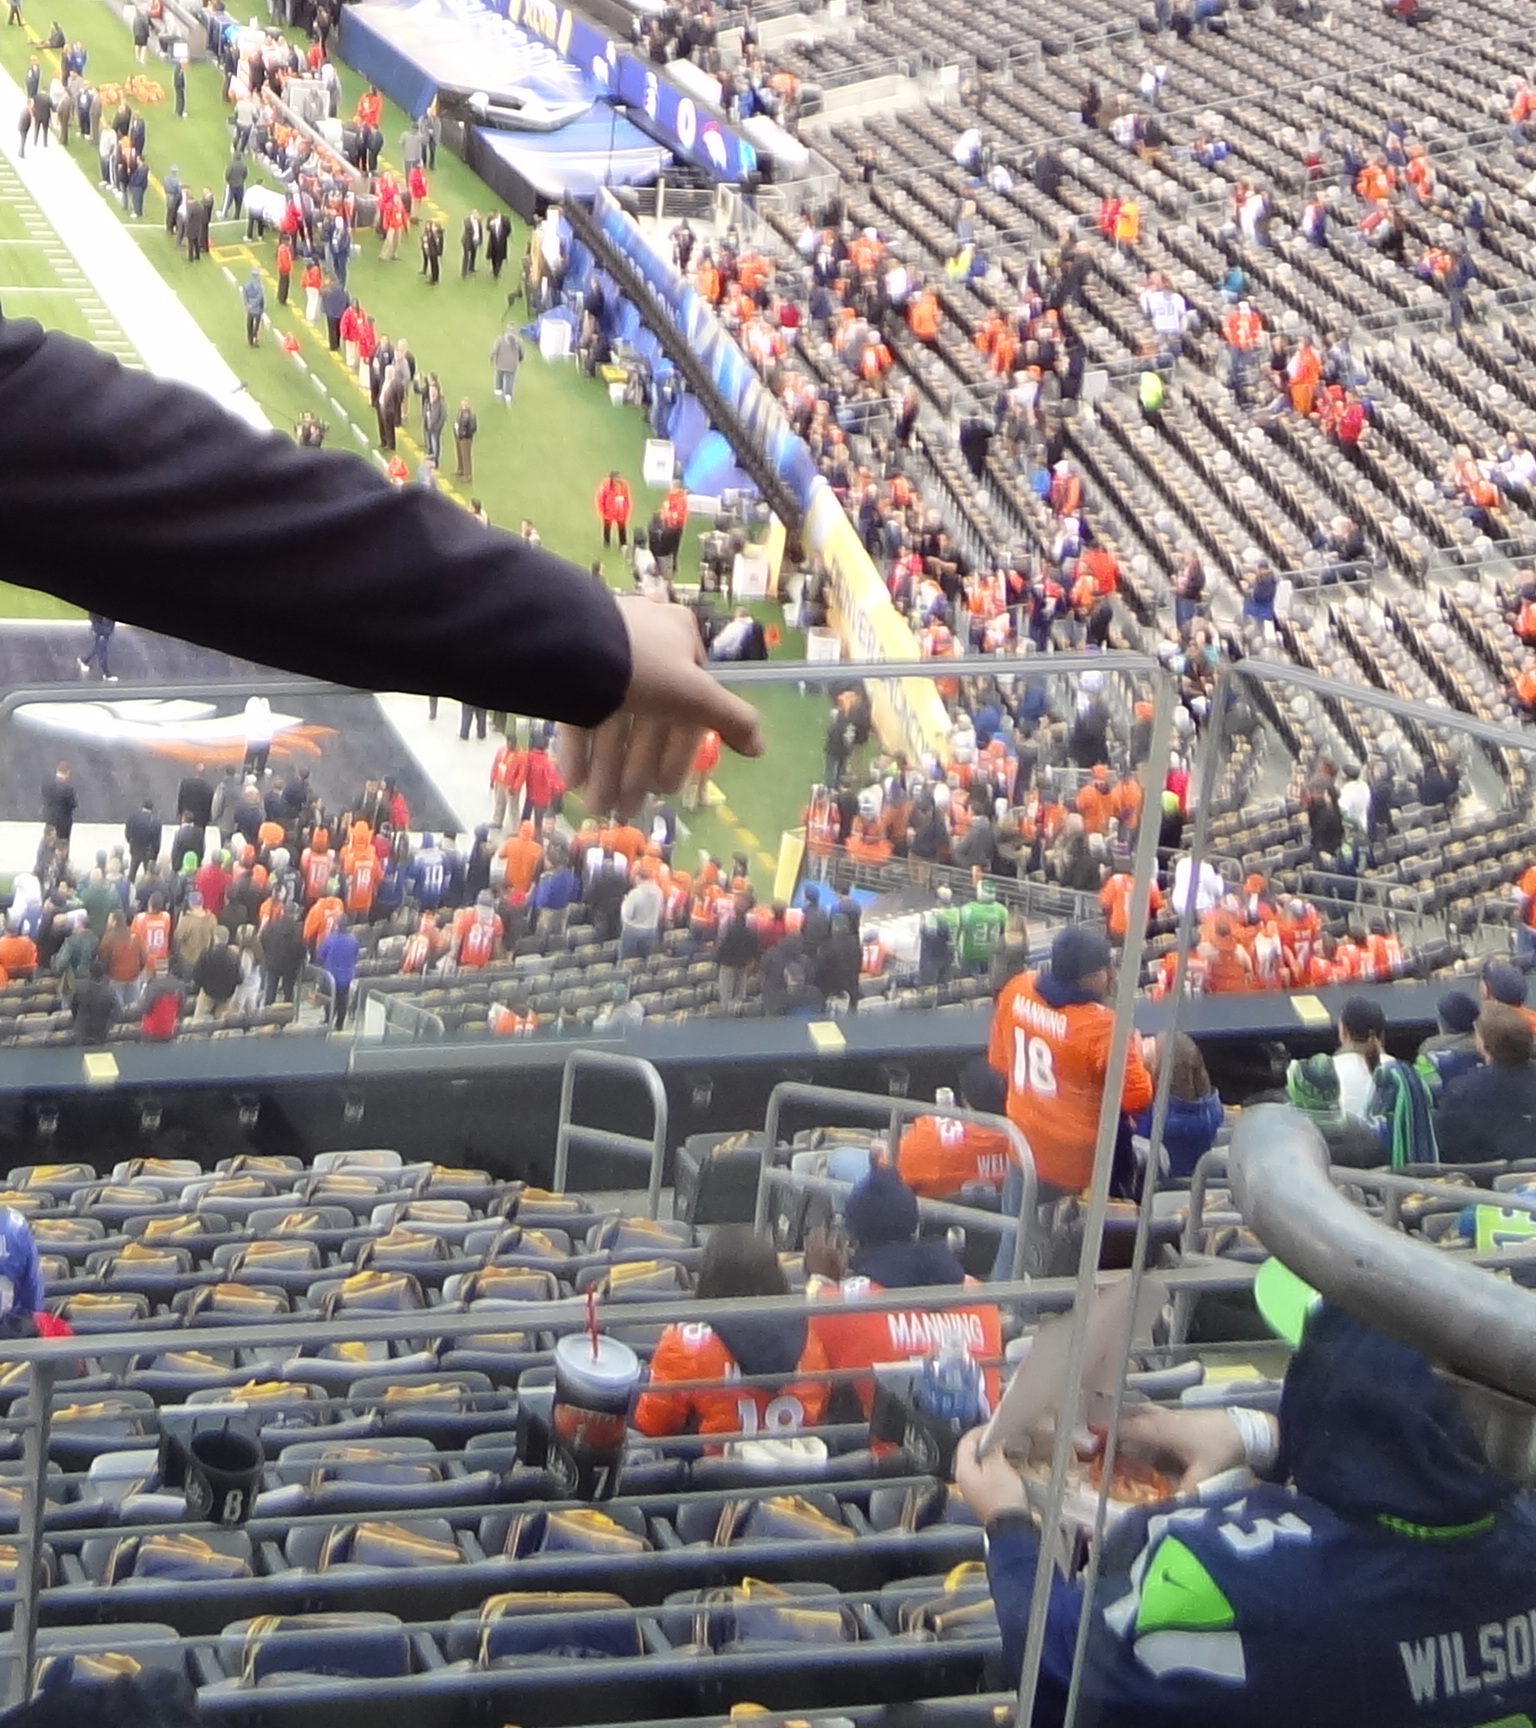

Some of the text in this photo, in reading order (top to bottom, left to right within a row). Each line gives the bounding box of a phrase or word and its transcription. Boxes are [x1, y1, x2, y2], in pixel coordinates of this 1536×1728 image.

[1012, 993, 1068, 1042] MANNING
[1014, 1026, 1058, 1098] 18
[887, 1313, 984, 1351] MANNING
[593, 1467, 611, 1499] 7
[223, 1489, 243, 1522] 8
